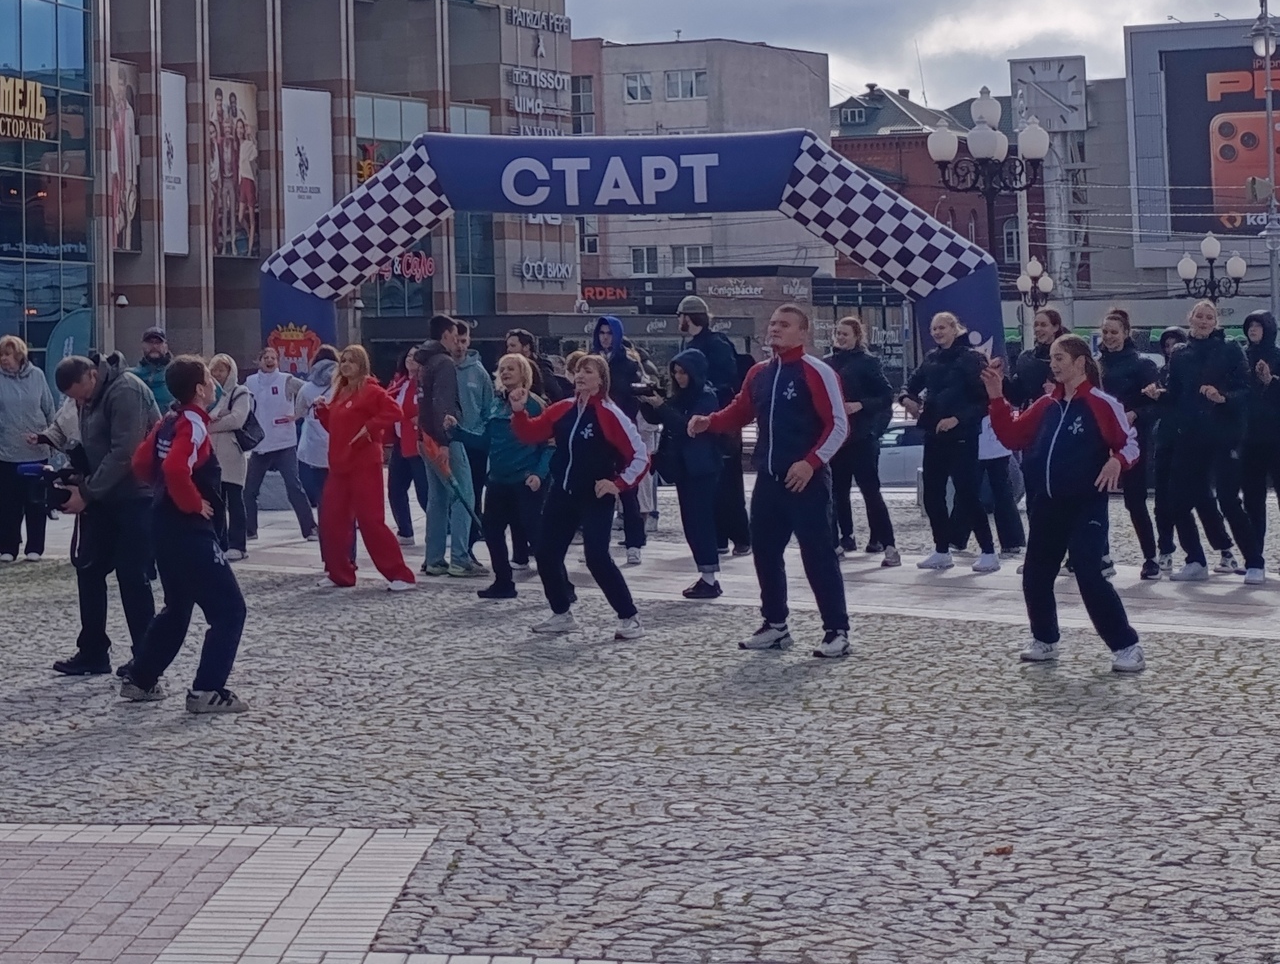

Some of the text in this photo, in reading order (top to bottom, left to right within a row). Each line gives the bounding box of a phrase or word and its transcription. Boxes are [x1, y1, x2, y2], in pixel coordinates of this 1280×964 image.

[512, 6, 569, 33] PATRIZIA PEPE
[529, 71, 572, 91] TISSOT
[501, 153, 719, 206] СТАРТ
[547, 261, 573, 279] ВИЖУ
[581, 286, 628, 300] RDEN
